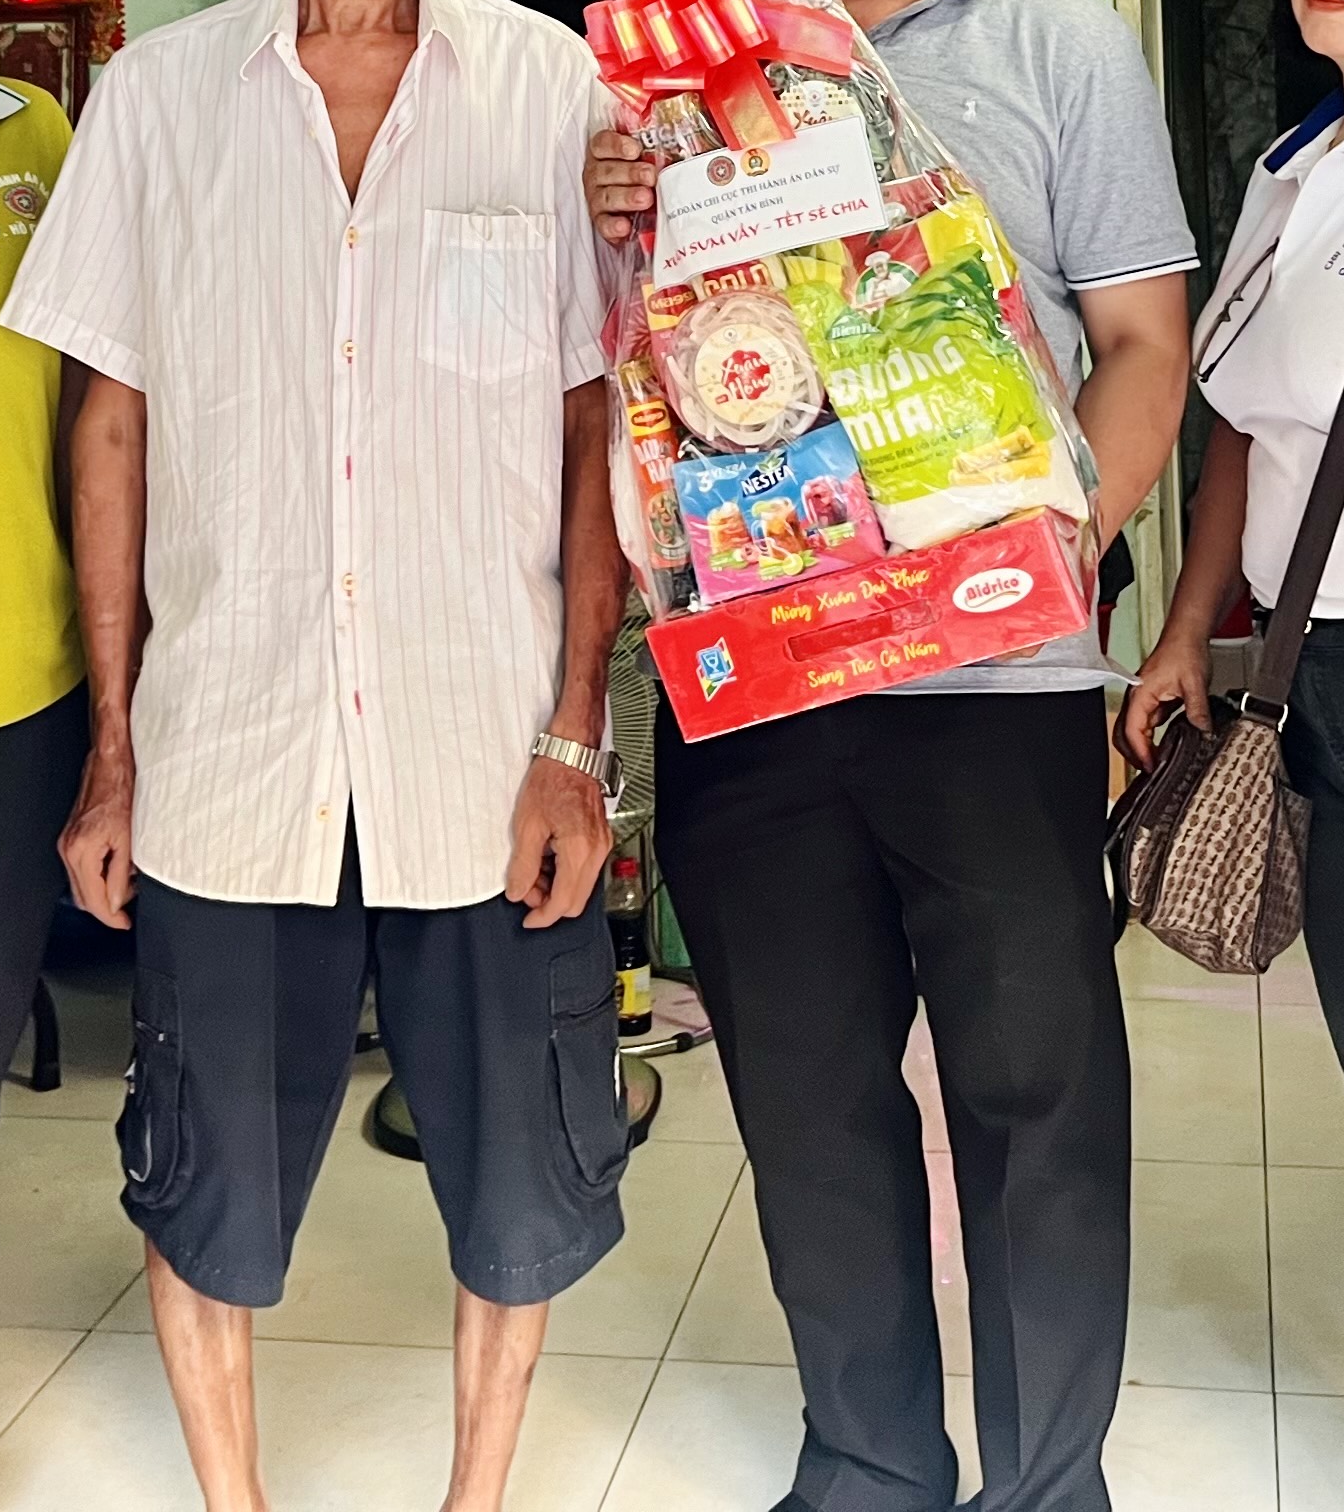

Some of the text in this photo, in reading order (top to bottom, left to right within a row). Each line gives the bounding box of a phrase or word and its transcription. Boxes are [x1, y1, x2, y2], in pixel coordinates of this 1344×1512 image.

[704, 194, 720, 207] CHI
[721, 188, 739, 203] CỤC
[741, 184, 758, 196] THI
[759, 178, 788, 193] HÀNH
[789, 173, 803, 186] ÁN
[711, 195, 784, 225] QUẬN TÂN BÌNH
[689, 235, 725, 255] SUM
[831, 198, 869, 217] CHIA
[697, 471, 713, 492] 3
[741, 464, 798, 494] NESTEA
[966, 577, 1020, 601] Bidrico
[808, 670, 845, 688] Sung
